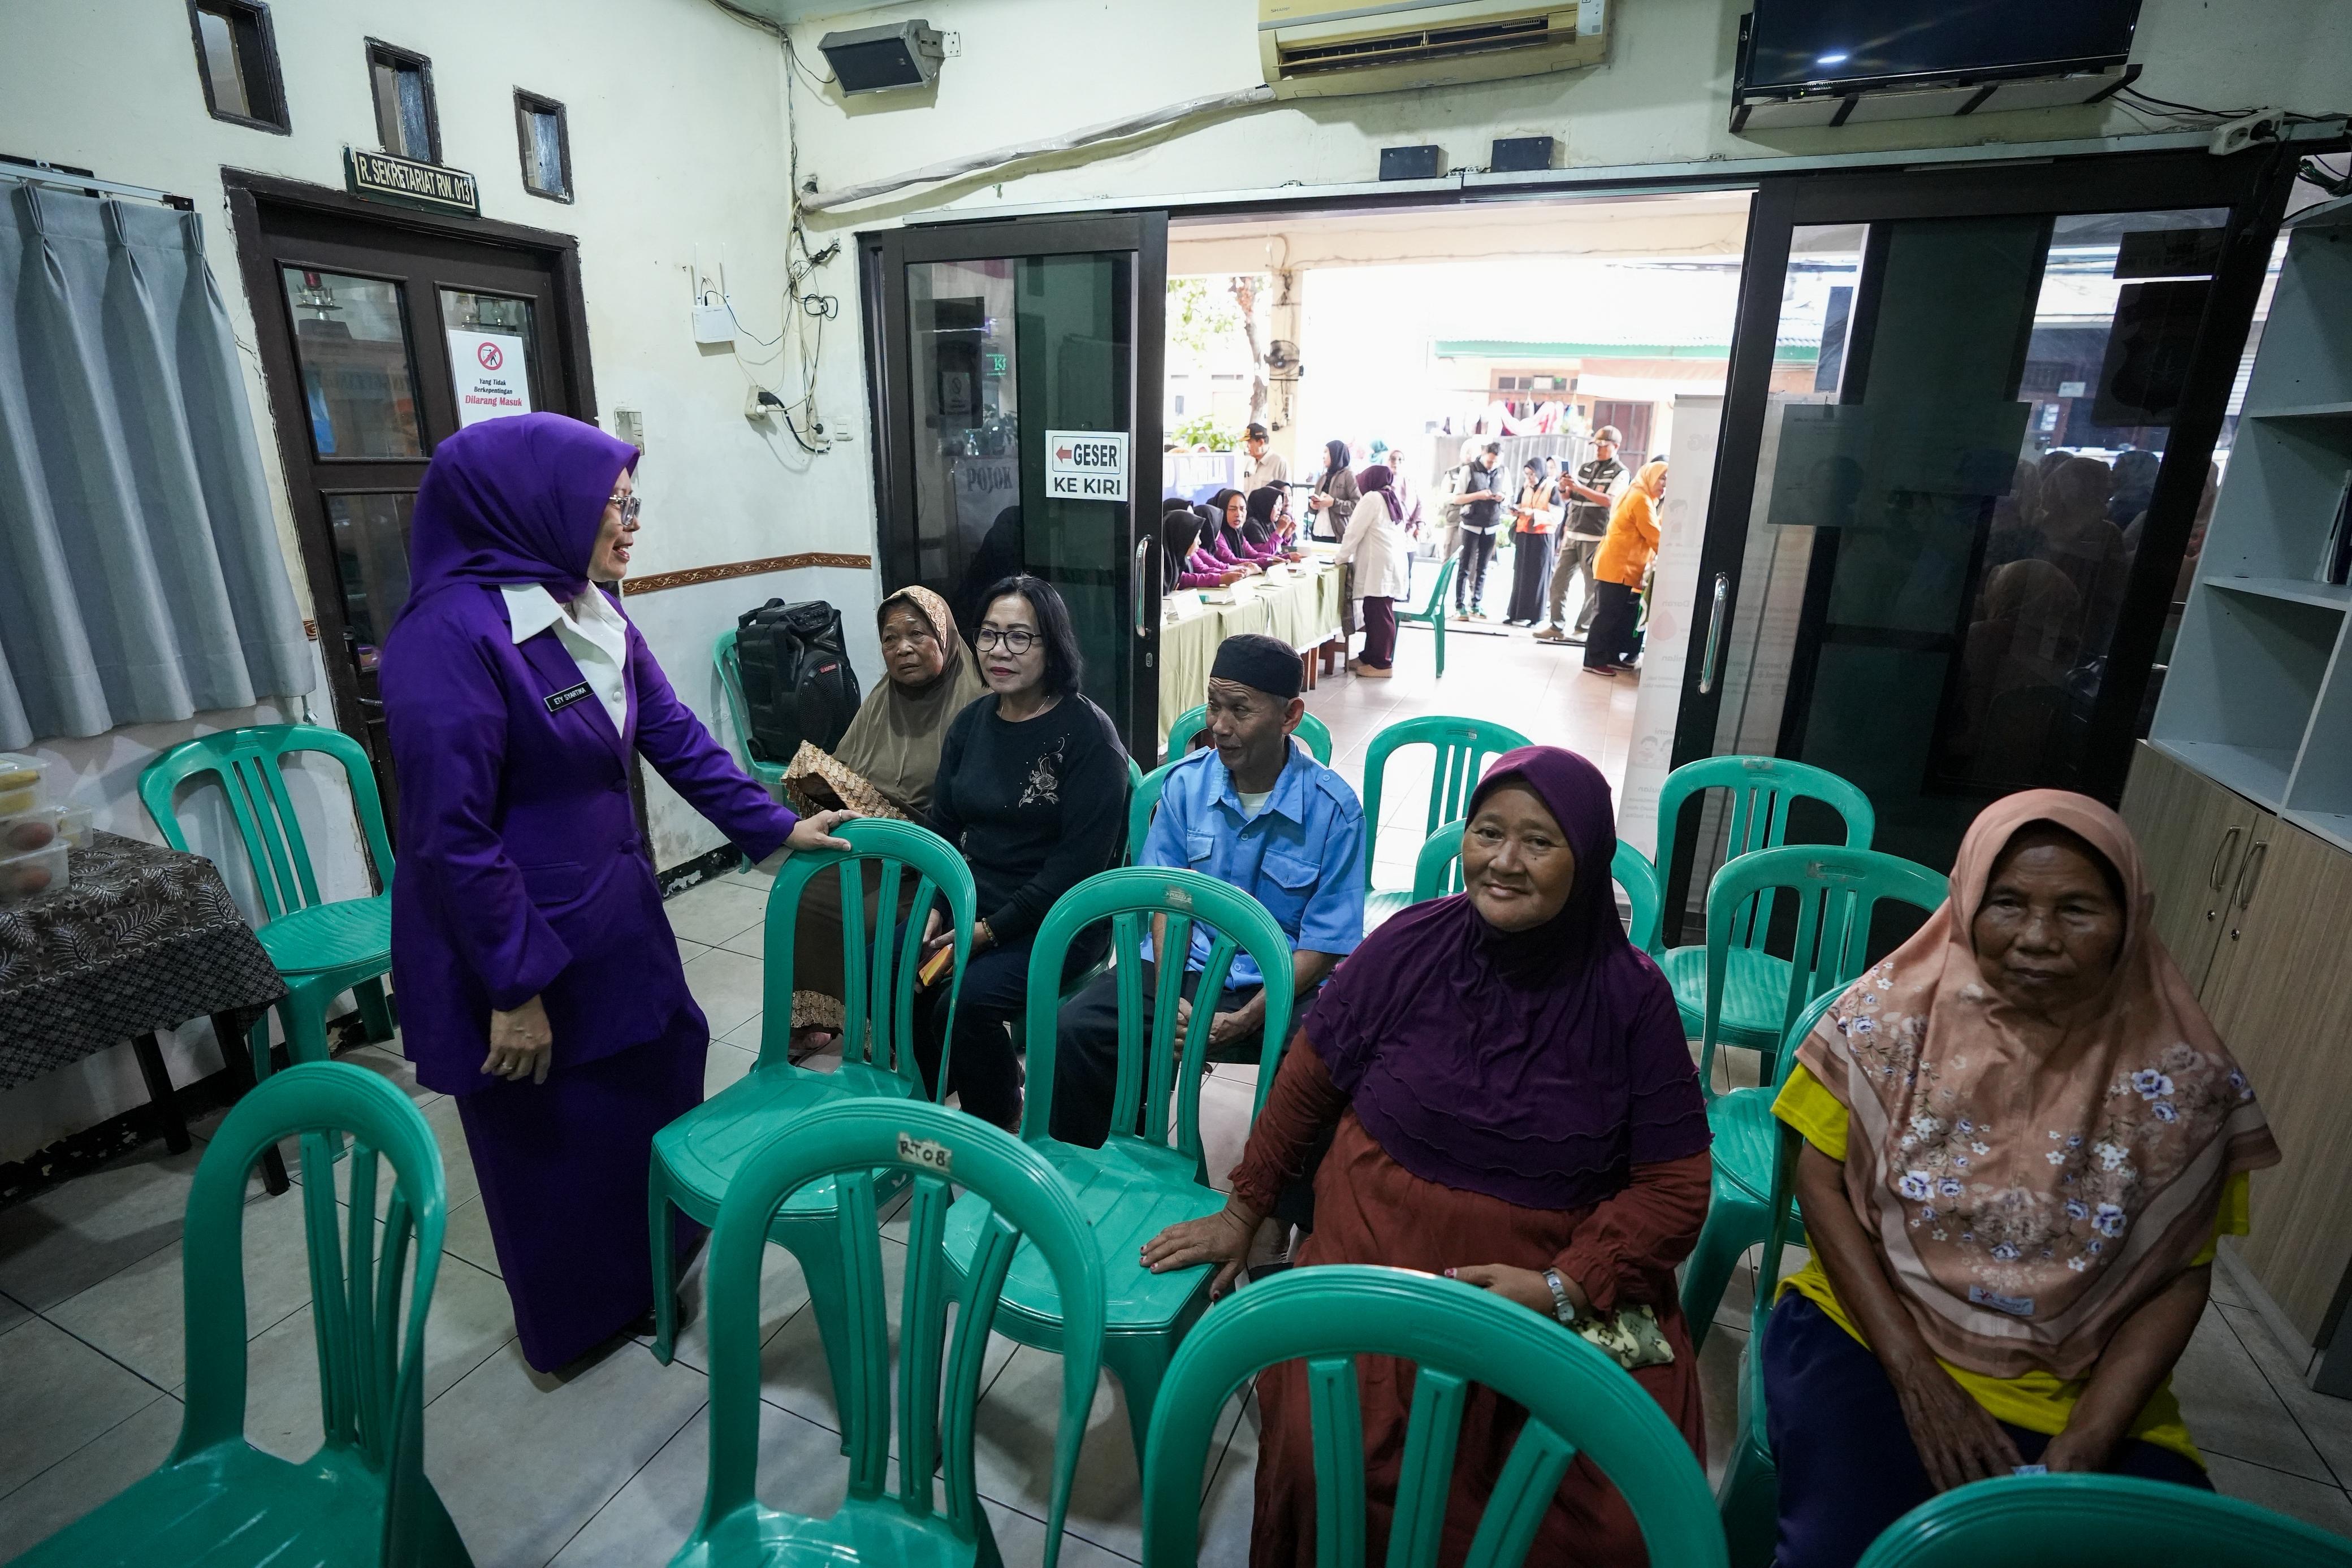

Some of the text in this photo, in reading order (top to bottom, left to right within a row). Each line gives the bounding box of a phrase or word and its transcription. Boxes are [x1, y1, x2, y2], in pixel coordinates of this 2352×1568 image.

[359, 156, 470, 202] R. SEKRETARIAT RW. 013
[465, 395, 522, 406] Dilarang Masuk
[1074, 444, 1117, 467] GESER
[1054, 477, 1121, 495] KE KIRI
[554, 696, 564, 705] ETY
